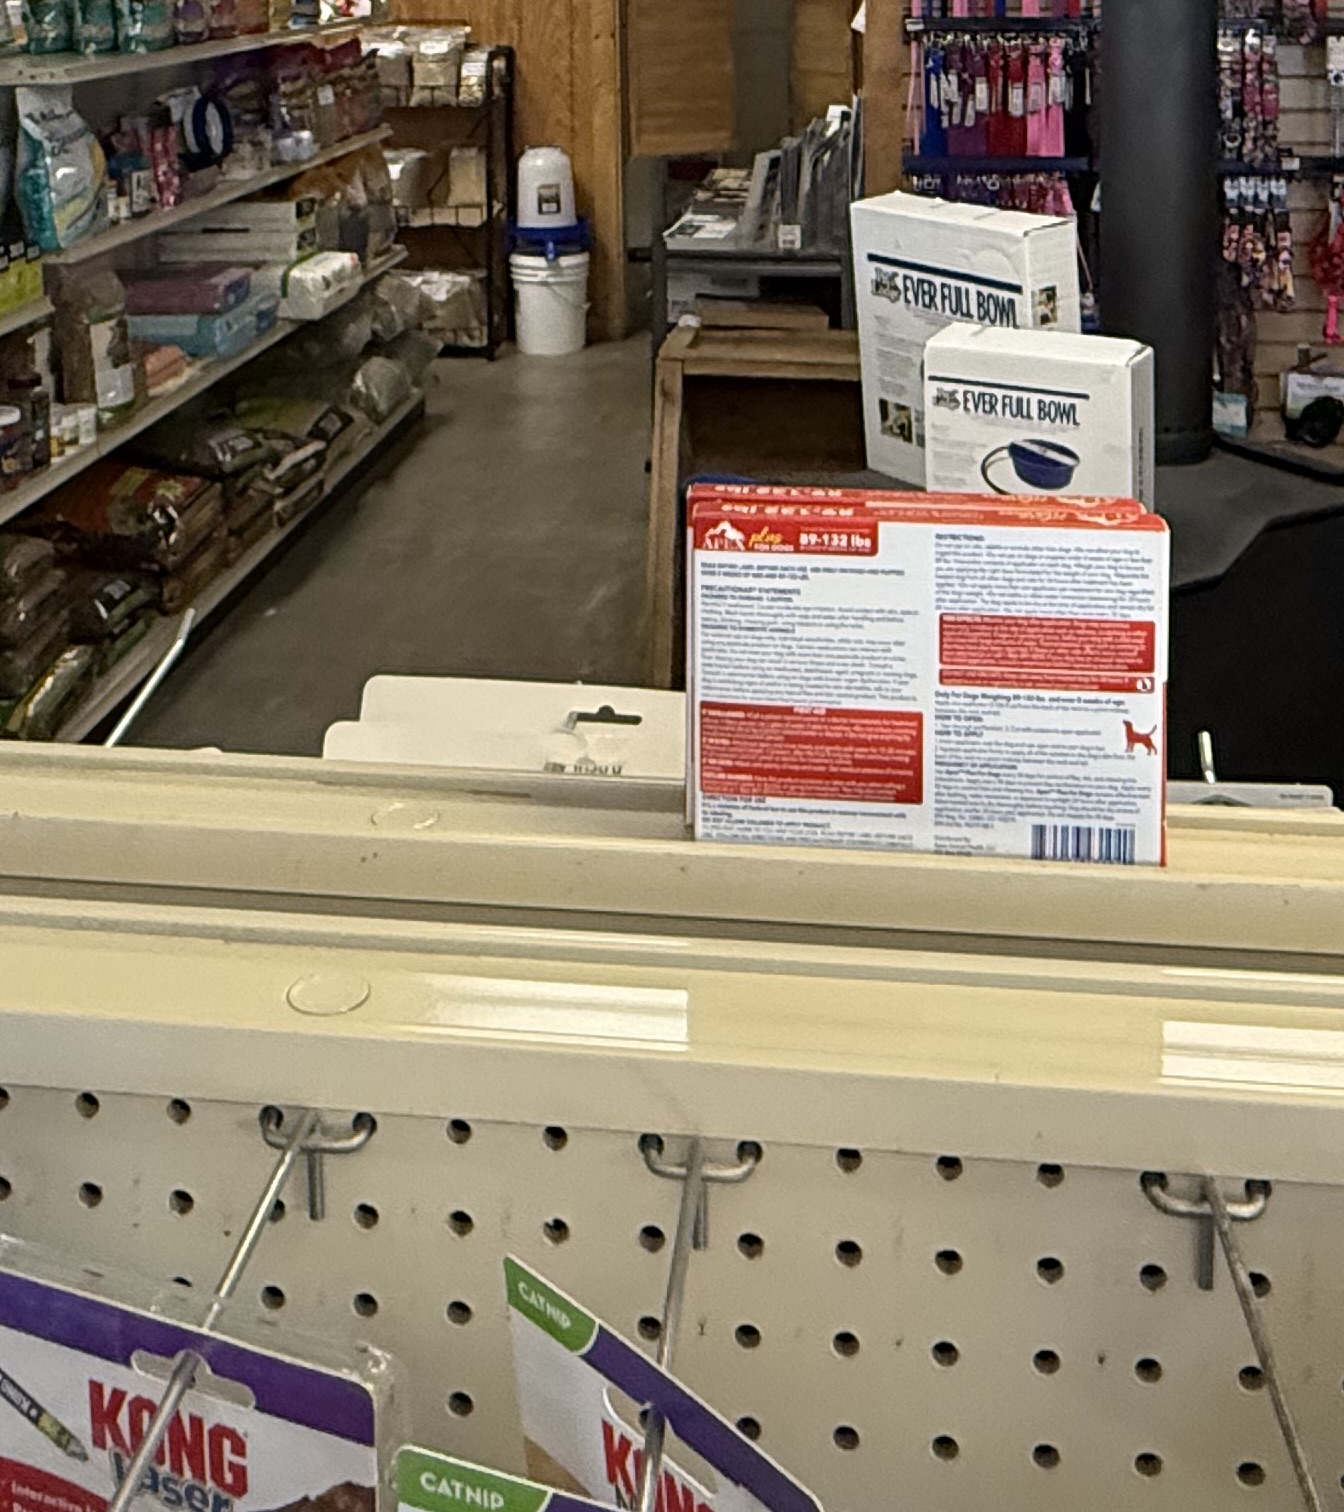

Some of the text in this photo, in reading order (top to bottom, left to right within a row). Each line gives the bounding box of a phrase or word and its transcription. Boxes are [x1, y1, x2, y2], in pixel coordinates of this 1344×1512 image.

[902, 274, 939, 311] EVER
[940, 282, 974, 320] FULL
[976, 290, 1020, 330] BOWL
[962, 390, 999, 416] EVER
[1001, 395, 1034, 421] FULL
[1037, 399, 1081, 426] BOWL
[799, 532, 872, 547] 89-132 lbs
[516, 1279, 573, 1331] CATNIP
[419, 1470, 505, 1511] CATNIP
